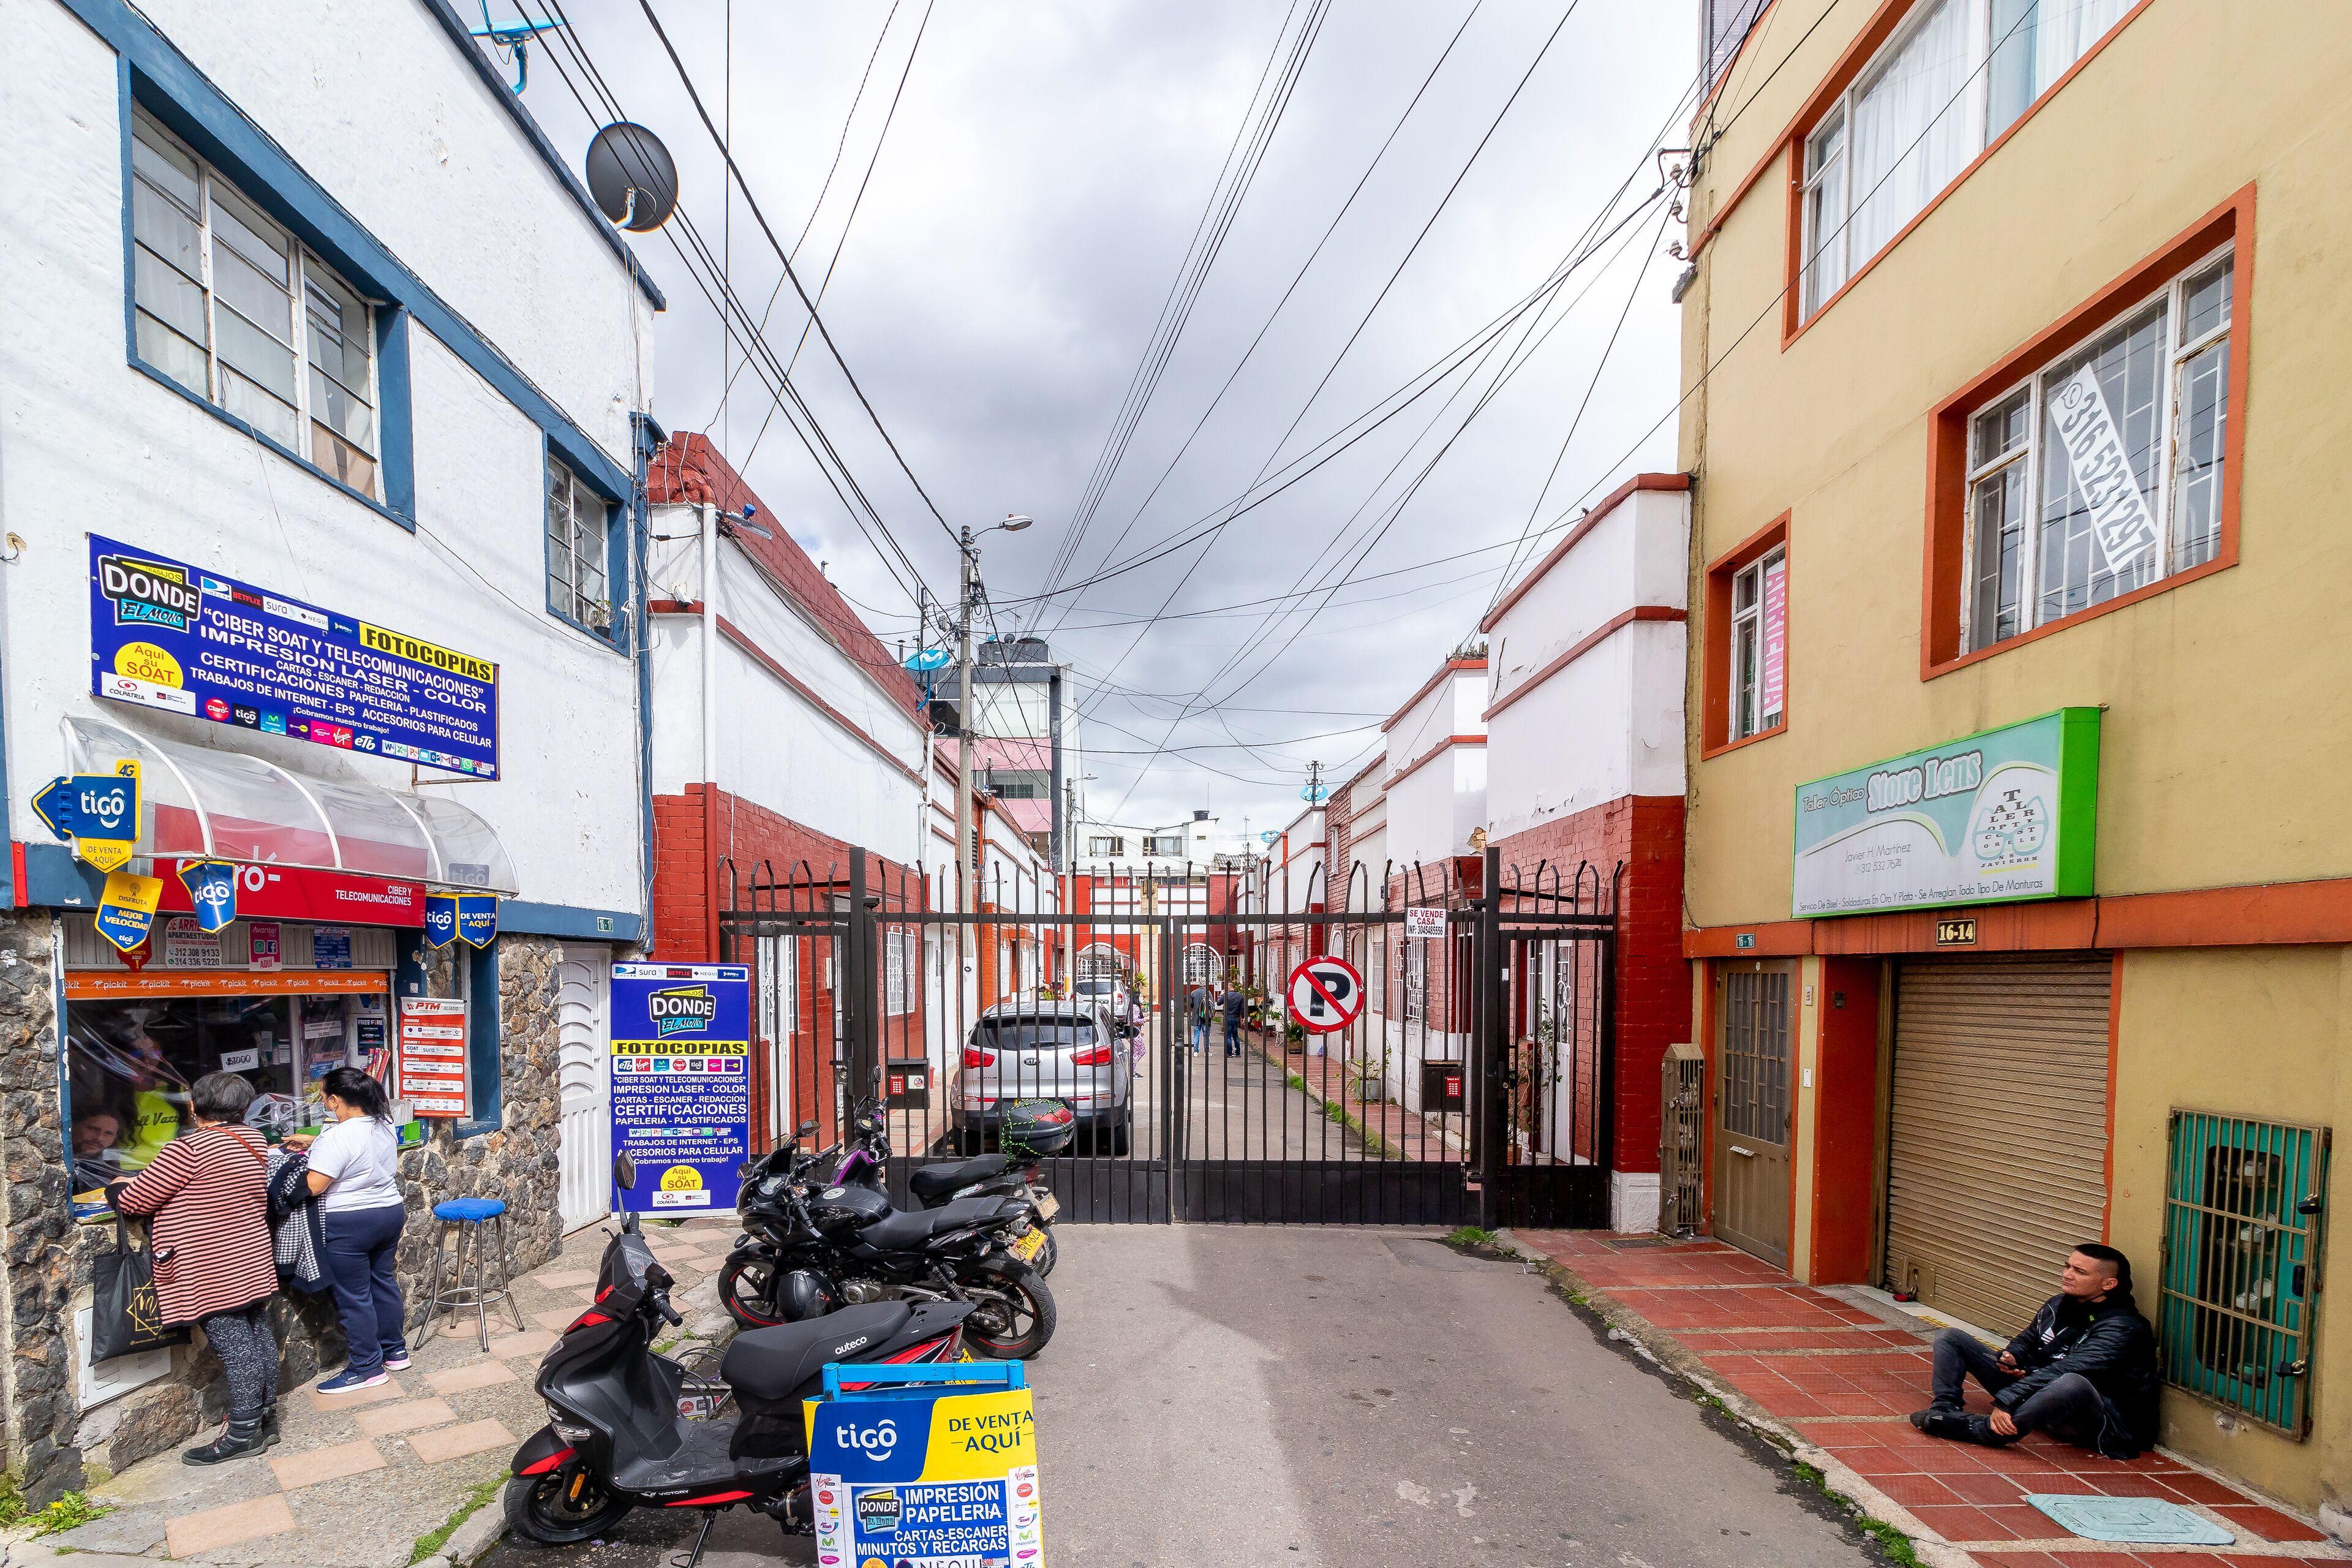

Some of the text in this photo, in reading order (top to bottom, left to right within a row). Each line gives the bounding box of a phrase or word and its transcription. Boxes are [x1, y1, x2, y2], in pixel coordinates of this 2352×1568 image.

[145, 567, 182, 582] TRABAJOS
[104, 564, 197, 613] DONDE
[203, 589, 230, 601] DIRECTV
[232, 591, 262, 606] NETFLIX
[266, 601, 288, 615] sura
[308, 614, 328, 626] NEQUI
[268, 626, 309, 651] SOAT
[312, 639, 322, 655] Y
[366, 627, 491, 681] FOTOCOPIAS
[143, 658, 157, 668] su
[200, 625, 487, 714] IMPRESION LASER COLOR
[127, 662, 175, 683] SOAT
[276, 660, 410, 703] CARTAS ESCANER REDACCION
[109, 688, 145, 701] COLPATRIA
[200, 652, 478, 732] CERTIFICACIONES PAPELERIA PLASTIFICADOS
[190, 666, 492, 748] TRABAJOS DE INTERNET EPS ACCESORIOS PARA CELULAR
[293, 706, 390, 734] ¡Cobramos nuestro trabajo!
[119, 764, 135, 777] 4G
[1803, 750, 1983, 813] Taller Óptico Store Lens
[1845, 850, 1866, 862] Javier
[1861, 858, 1902, 873] 312 532 7674
[335, 889, 412, 906] TELECOMUNICACIONES
[388, 886, 407, 895] CIBER
[1798, 902, 1817, 911] Servicio
[1826, 898, 1838, 908] Bisel
[1842, 896, 1871, 908] Soldaduras
[1880, 893, 1892, 903] Oro
[1899, 891, 1913, 902] Plata
[1918, 889, 1927, 899] Se
[1928, 886, 1956, 900] Arreglan
[1959, 883, 1975, 896] Todo
[1977, 882, 1991, 896] Tipo
[1992, 881, 2004, 892] De
[2005, 879, 2043, 891] Monturas
[118, 895, 148, 906] DISFRUTA
[104, 915, 148, 930] VELOCIDAD
[118, 910, 143, 921] MEJOR
[168, 932, 217, 940] APARTAESTUDIO
[1939, 922, 1975, 941] 16-14
[175, 948, 220, 957] 312 308 9133
[175, 957, 186, 966] 314
[188, 957, 202, 966] 336
[1310, 971, 1351, 1017] P
[415, 1002, 441, 1011] PTM
[652, 997, 713, 1016] DONDE
[617, 1042, 745, 1055] FOTOCOPIAS
[613, 1085, 747, 1095] IMPRESION LASER COLOR
[614, 1104, 747, 1116] CERTIFICACIONES
[674, 1116, 746, 1125] PLASTIFICADOS
[617, 1148, 676, 1157] ACESORIOS
[703, 1147, 743, 1155] CELULAR
[668, 1179, 698, 1189] SOAT
[835, 1336, 867, 1355] auteco
[949, 1417, 970, 1433] DE
[975, 1409, 1034, 1430] VENTA
[965, 1427, 1020, 1454] AQUÍ
[816, 1474, 832, 1488] Virgin
[1015, 1468, 1031, 1481] Virgin
[905, 1482, 1000, 1506] IMPRESIÓN
[861, 1501, 899, 1512] DONDE
[907, 1502, 1003, 1524] PAPELERIA
[894, 1525, 1008, 1542] CARTAS-ESCANER
[857, 1537, 1008, 1556] MINUTOS Y RECARGAS
